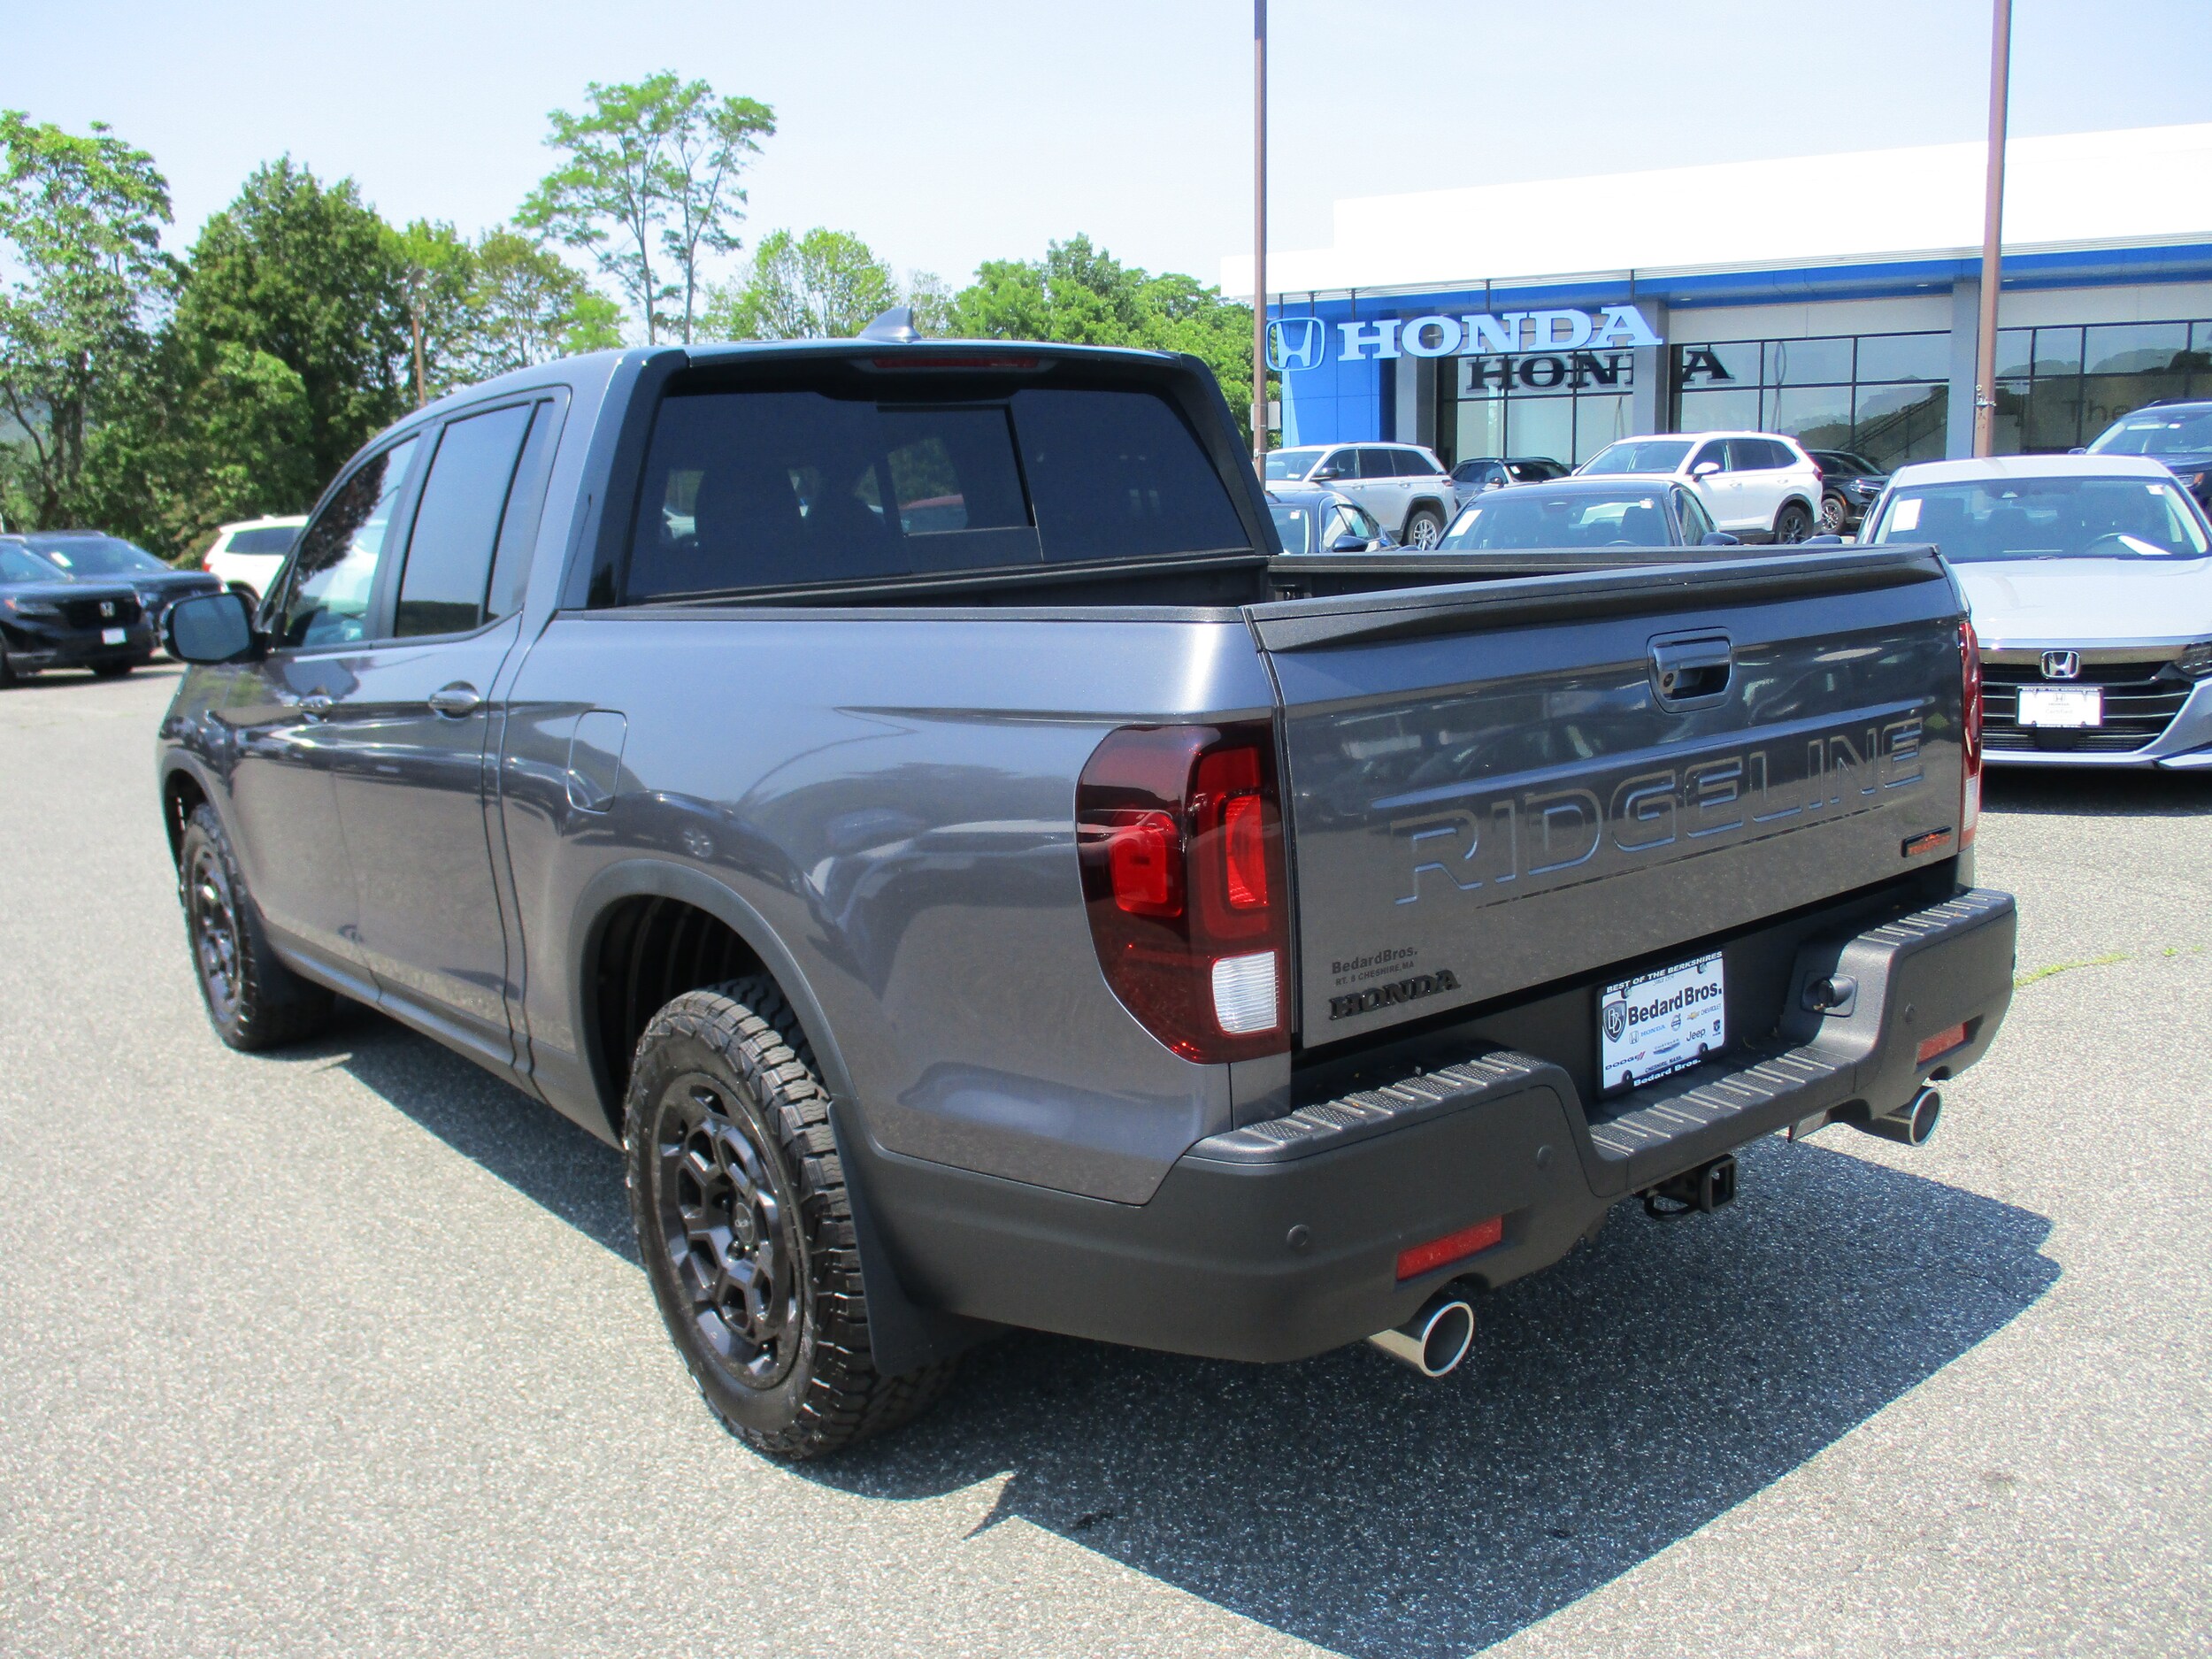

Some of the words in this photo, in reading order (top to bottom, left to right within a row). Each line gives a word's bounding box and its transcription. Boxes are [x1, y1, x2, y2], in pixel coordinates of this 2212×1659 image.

[1337, 305, 1663, 362] HONDA
[1465, 345, 1735, 394] HONA
[1389, 715, 1924, 906] RIDGELINE
[1606, 980, 1632, 994] BEST
[1632, 977, 1646, 986] OF
[1647, 970, 1666, 980] THE
[1667, 951, 1722, 973] BERKSHIRES
[1329, 970, 1462, 1021] HONDA
[1640, 1025, 1667, 1037] HONDA
[1686, 1029, 1707, 1042] Jeep
[1605, 1056, 1639, 1071] DODGE
[1633, 1069, 1672, 1087] Bedard
[1674, 1058, 1701, 1072] Bros.
